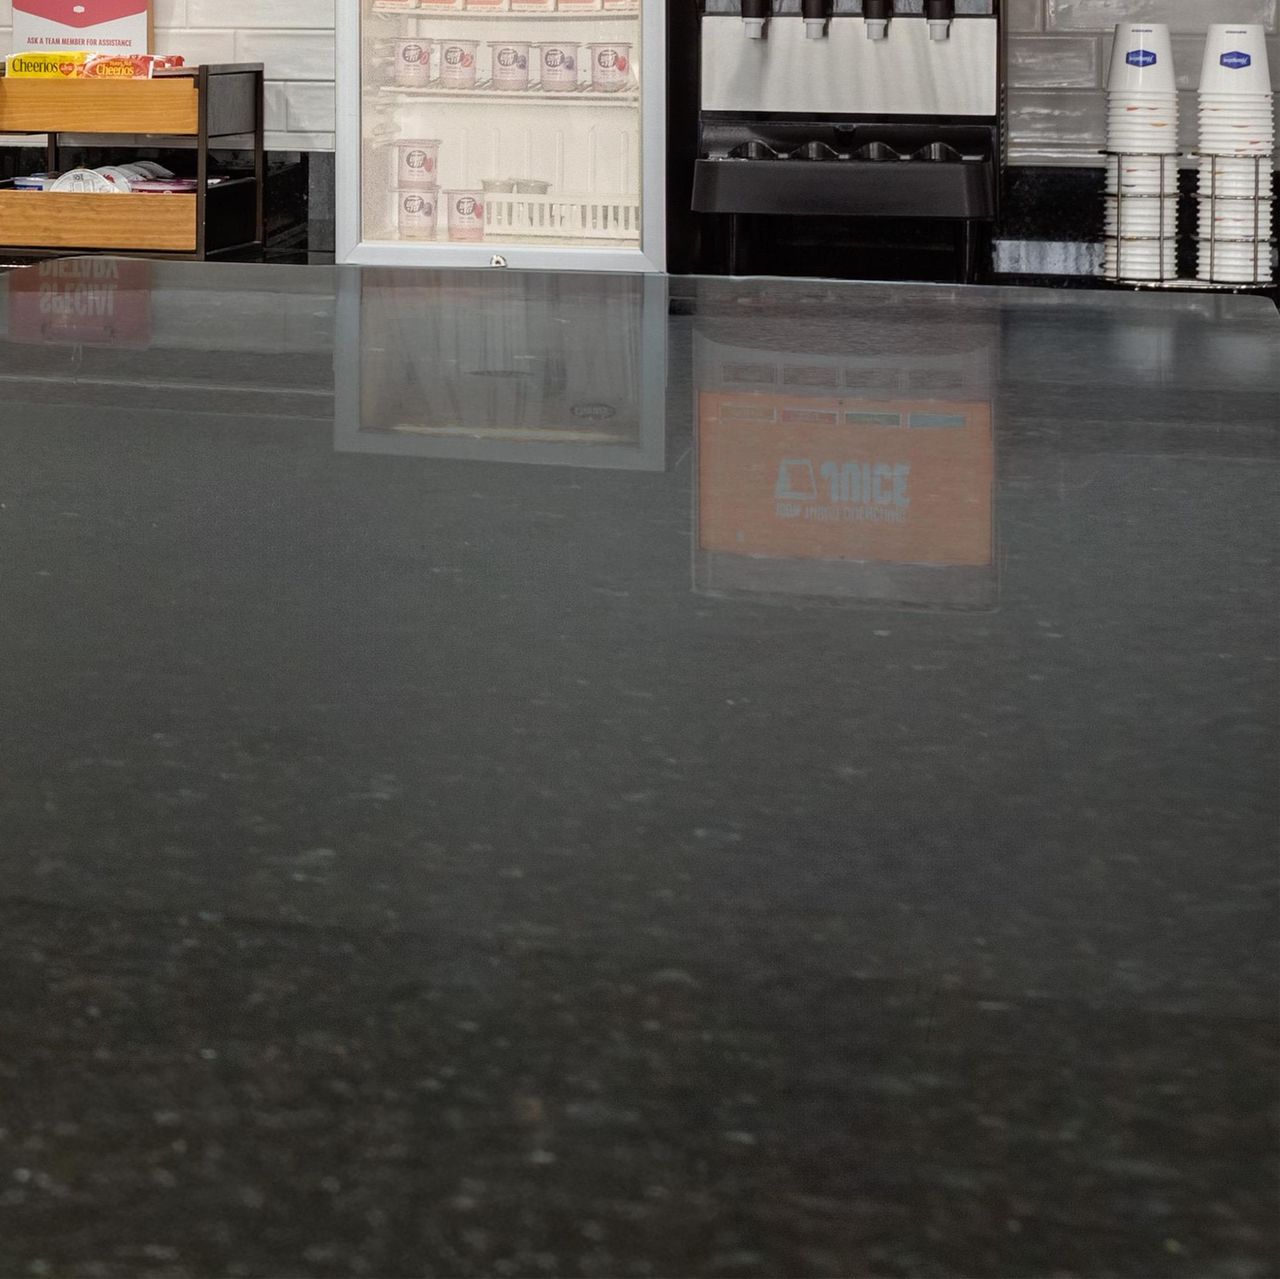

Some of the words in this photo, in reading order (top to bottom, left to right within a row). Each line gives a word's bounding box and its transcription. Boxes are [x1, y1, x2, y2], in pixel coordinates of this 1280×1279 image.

[27, 37, 38, 45] ASK
[45, 37, 61, 45] TEAM
[61, 38, 85, 46] MEMBER
[99, 39, 132, 47] ASSISTANCE
[12, 58, 58, 73] Cheerios
[96, 63, 135, 76] Cheerios
